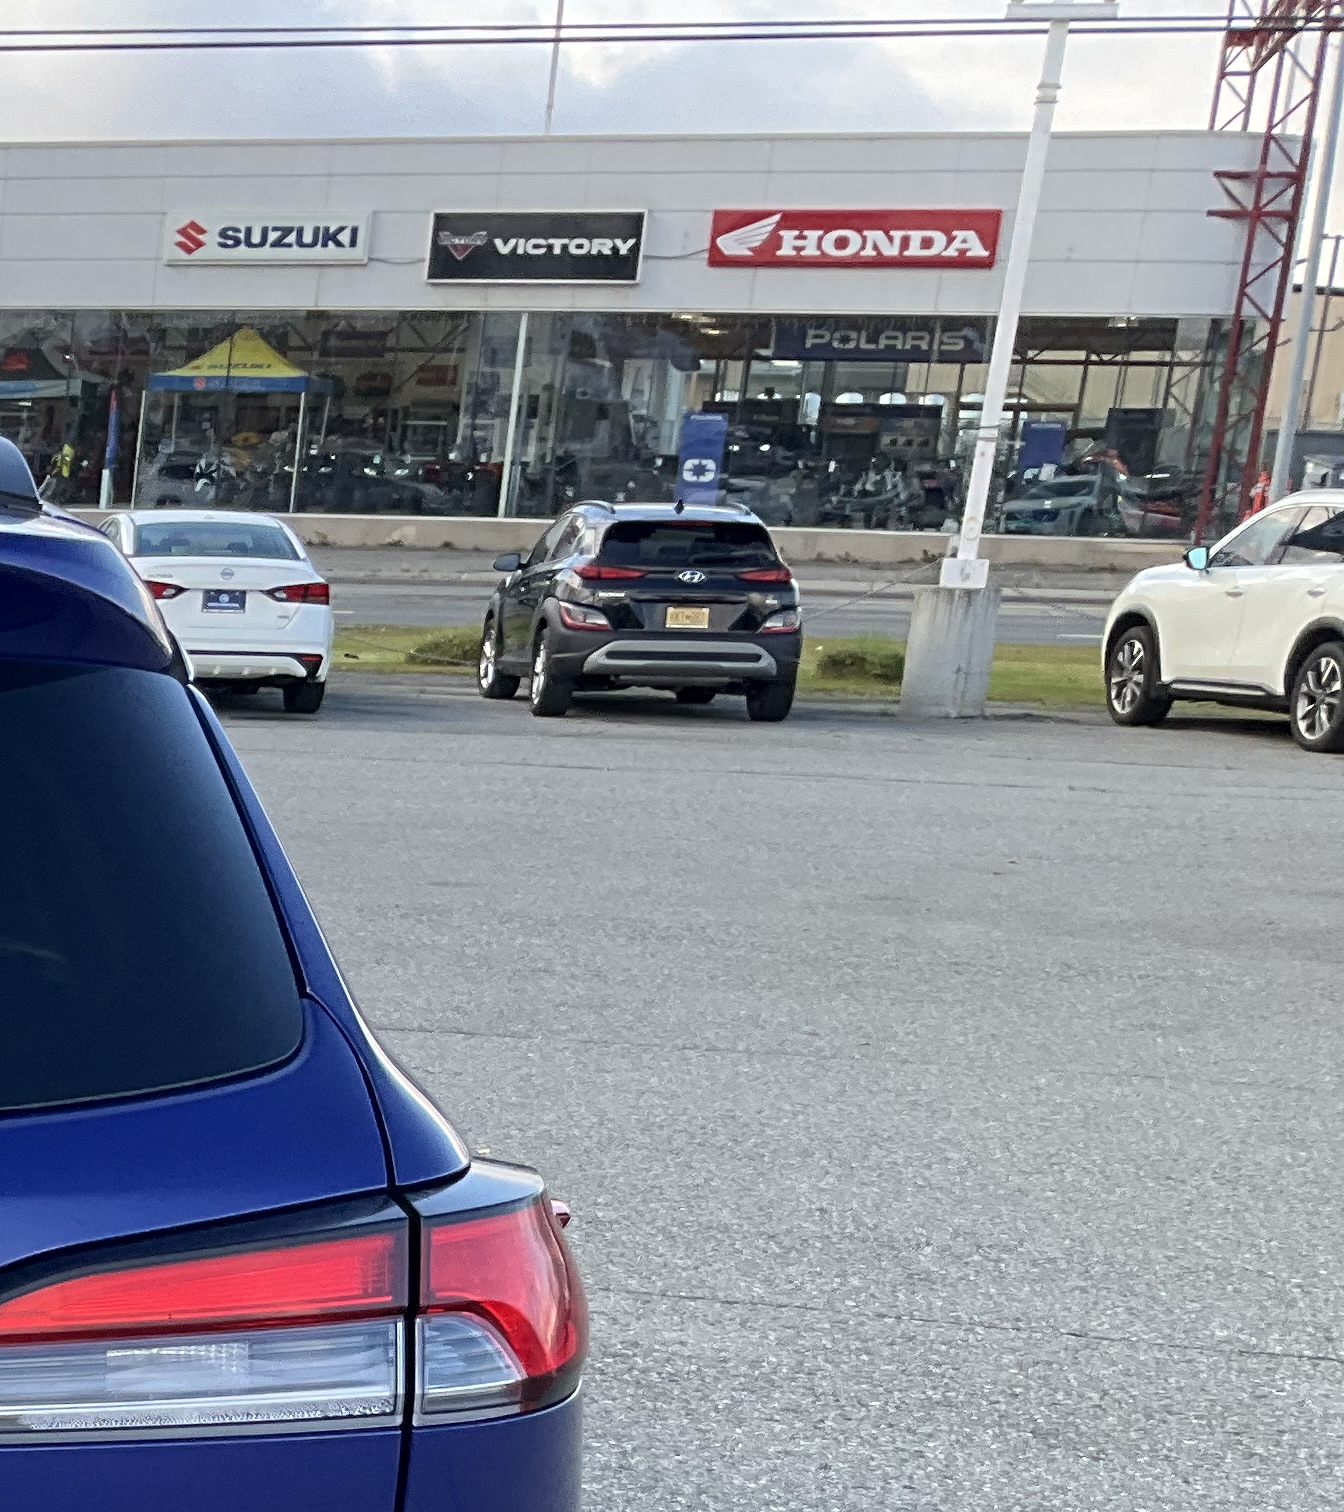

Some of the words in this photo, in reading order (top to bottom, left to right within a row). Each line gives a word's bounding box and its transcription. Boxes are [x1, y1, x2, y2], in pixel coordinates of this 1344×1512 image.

[217, 225, 359, 249] SUZUKI
[493, 238, 637, 255] VICTORY
[776, 229, 990, 257] HONDA
[805, 329, 966, 351] POLARIS
